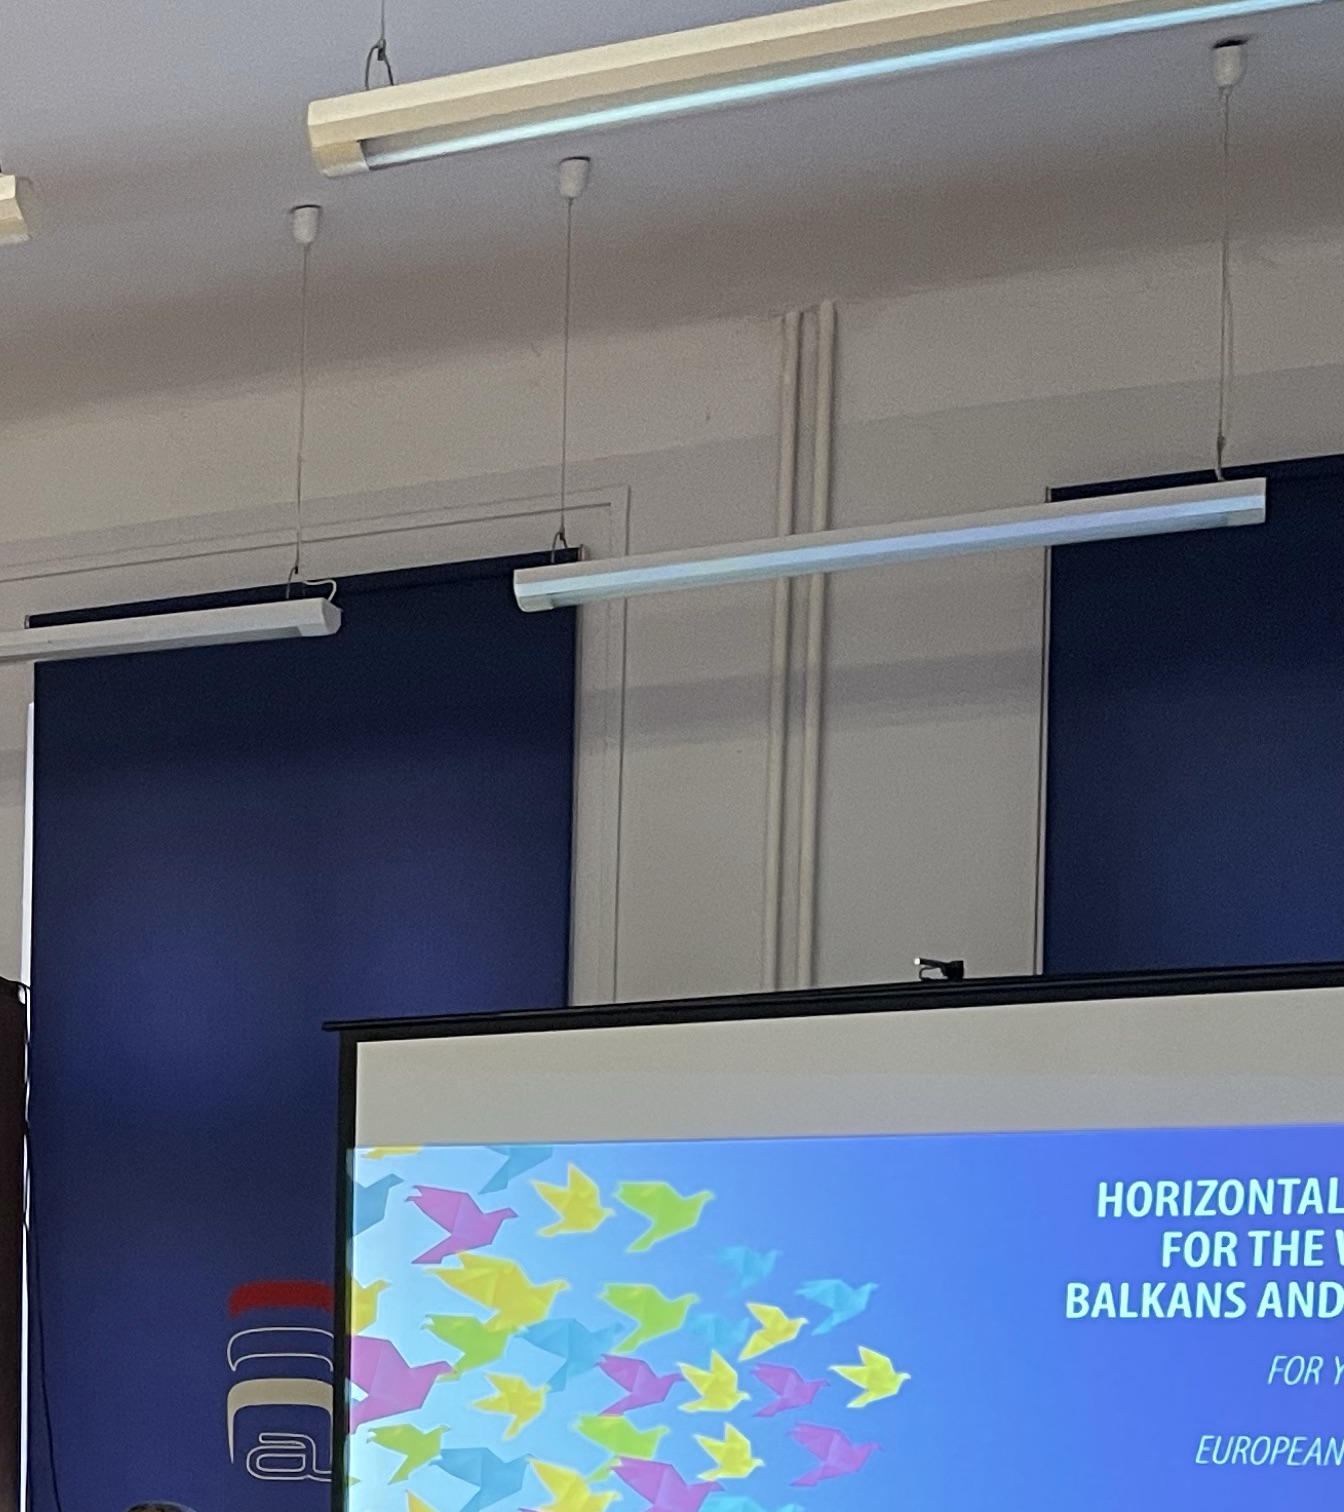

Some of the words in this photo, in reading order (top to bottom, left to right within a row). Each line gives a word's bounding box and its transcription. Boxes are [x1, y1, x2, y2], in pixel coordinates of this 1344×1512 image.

[1097, 1177, 1344, 1217] HORIZONTAL
[1162, 1231, 1237, 1267] FOR
[1247, 1229, 1325, 1267] THE
[1065, 1281, 1246, 1319] BALKANS
[1256, 1281, 1344, 1318] AND
[1267, 1355, 1324, 1386] FOR
[1195, 1435, 1344, 1466] EUROPEAN
